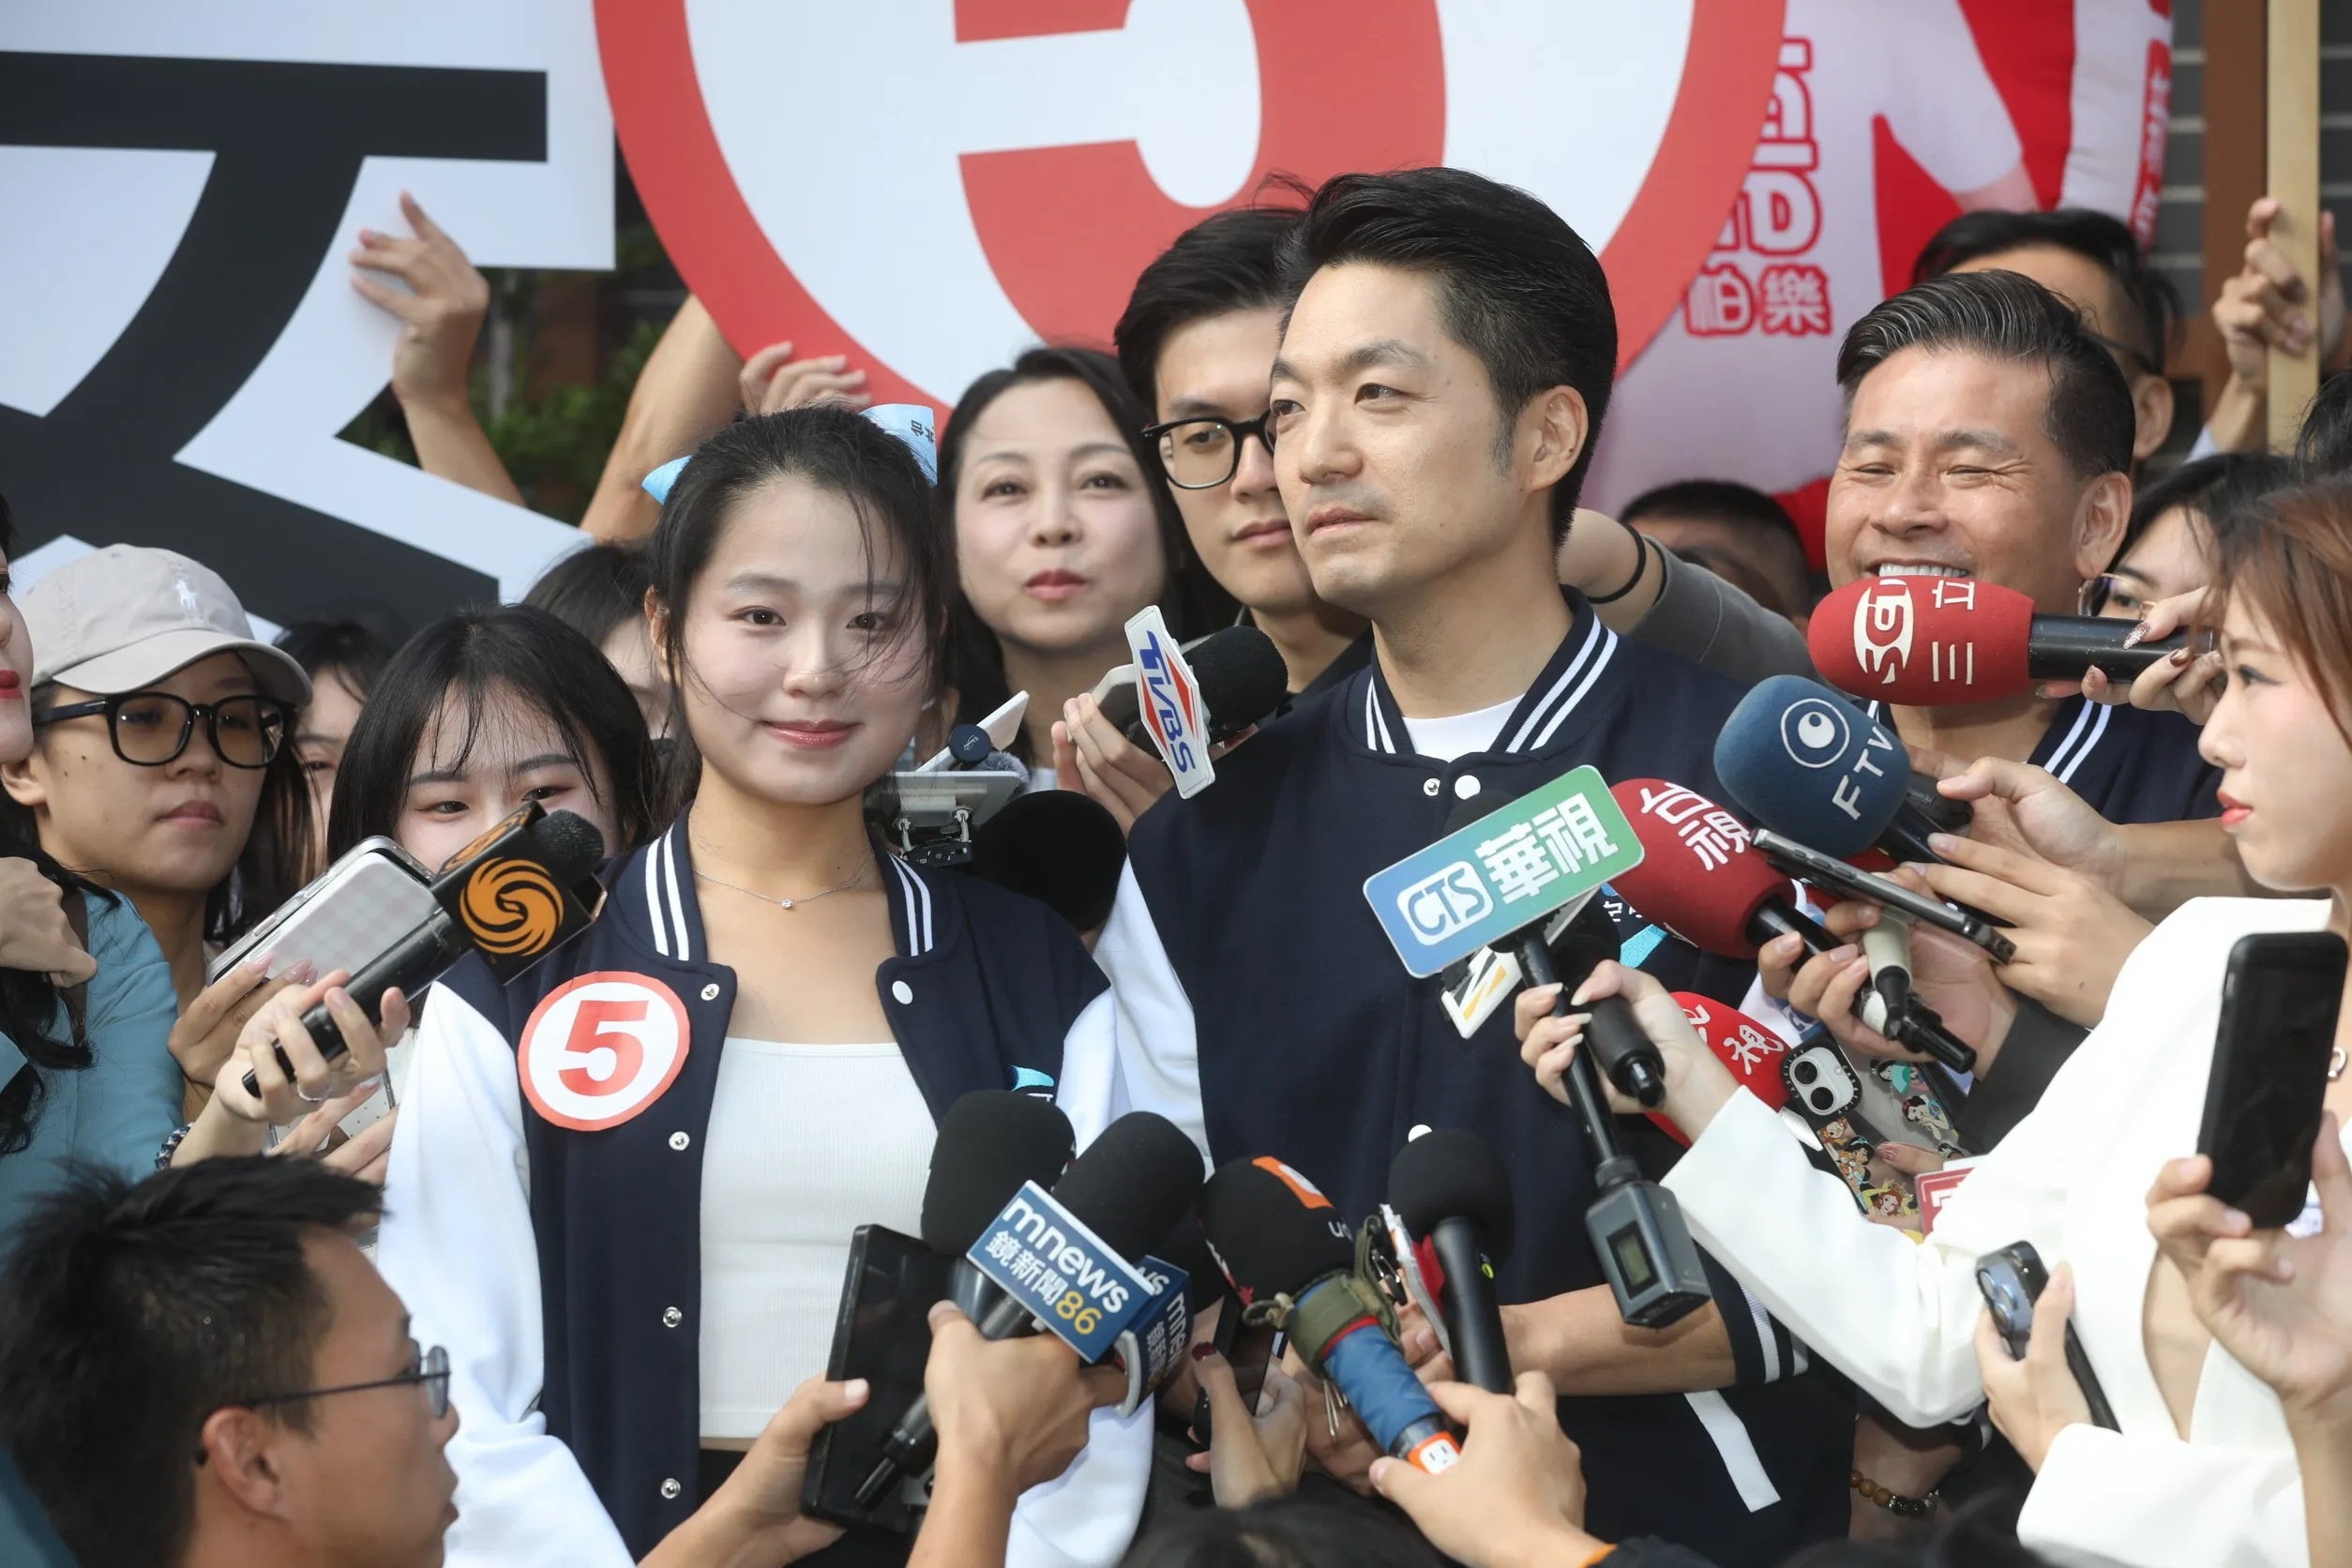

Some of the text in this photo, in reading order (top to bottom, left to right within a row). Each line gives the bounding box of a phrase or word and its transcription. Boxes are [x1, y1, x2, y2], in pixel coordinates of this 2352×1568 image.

[1931, 580, 1975, 686] 三立
[1138, 629, 1196, 774] TVBS
[1832, 726, 1894, 822] FTV
[1407, 792, 1621, 938] CTS 華視
[557, 1000, 650, 1097] 5
[985, 1229, 1069, 1306] 鏡新聞
[1055, 1290, 1103, 1335] 86
[1002, 1197, 1130, 1314] mnews
